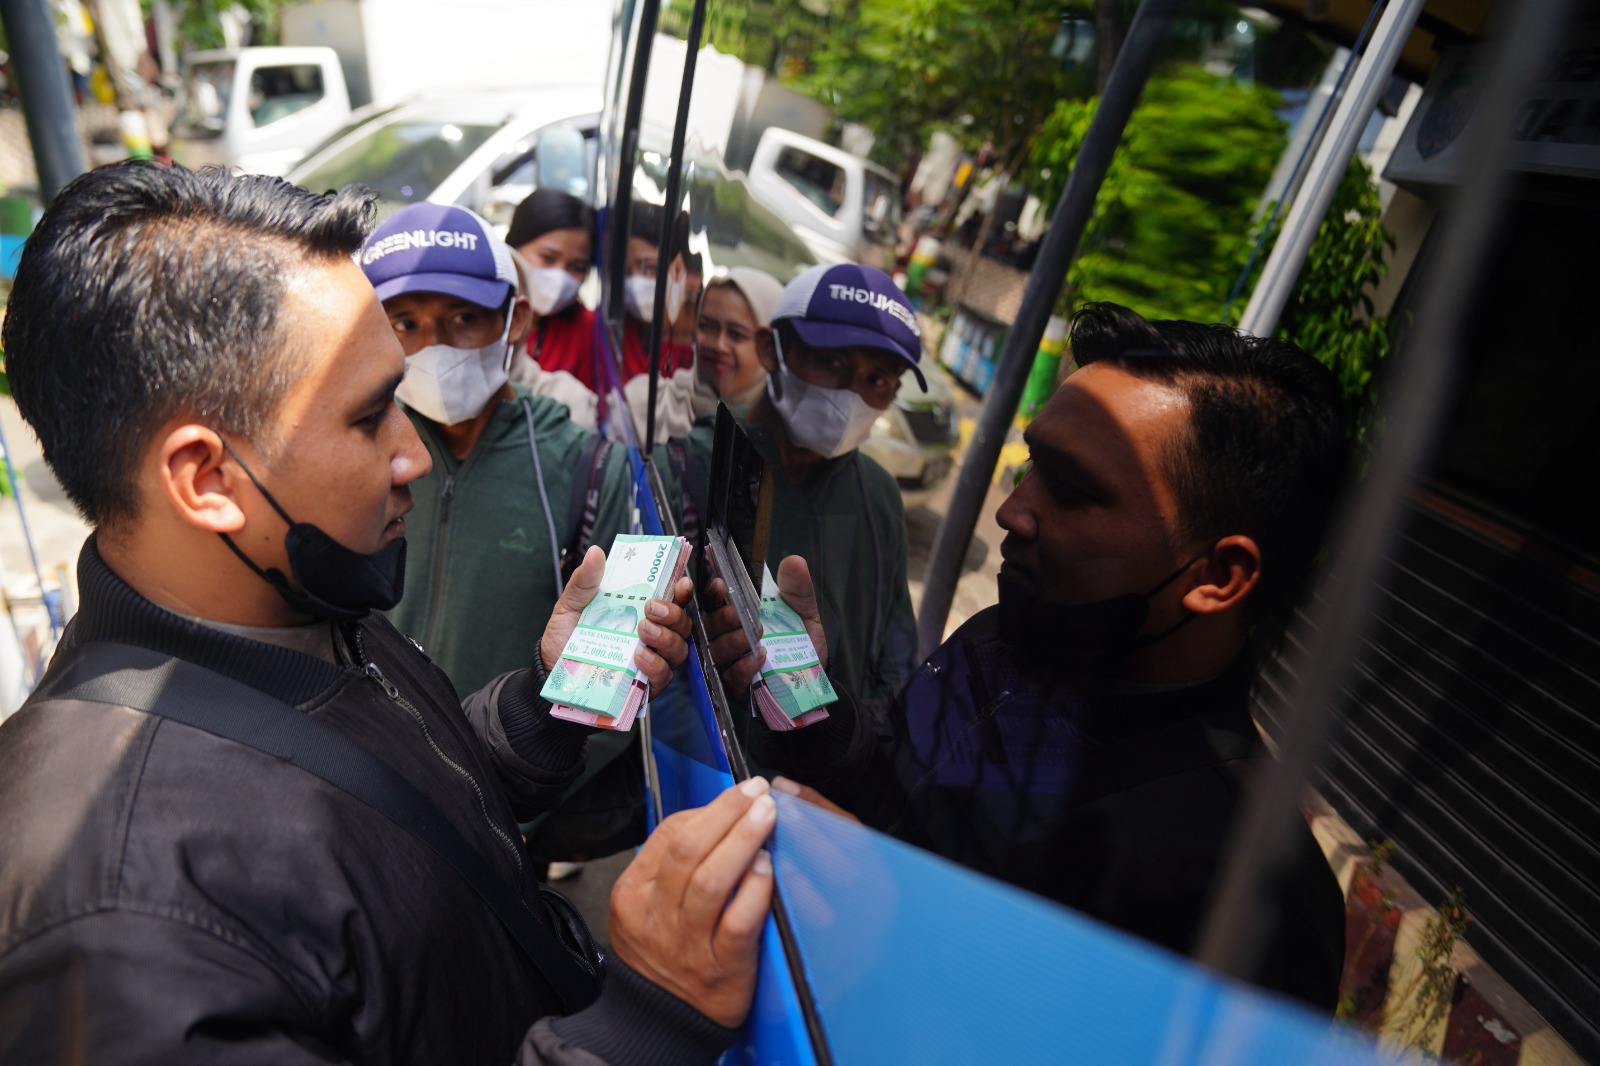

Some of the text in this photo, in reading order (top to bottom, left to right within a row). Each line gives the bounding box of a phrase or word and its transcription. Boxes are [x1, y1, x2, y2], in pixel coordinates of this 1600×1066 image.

[364, 229, 479, 265] GREENLIGHT
[647, 543, 668, 582] 20000
[578, 630, 598, 639] BANK
[597, 633, 631, 645] INDONESIA
[567, 642, 579, 656] Rp
[582, 645, 629, 664] 2.000.000,-
